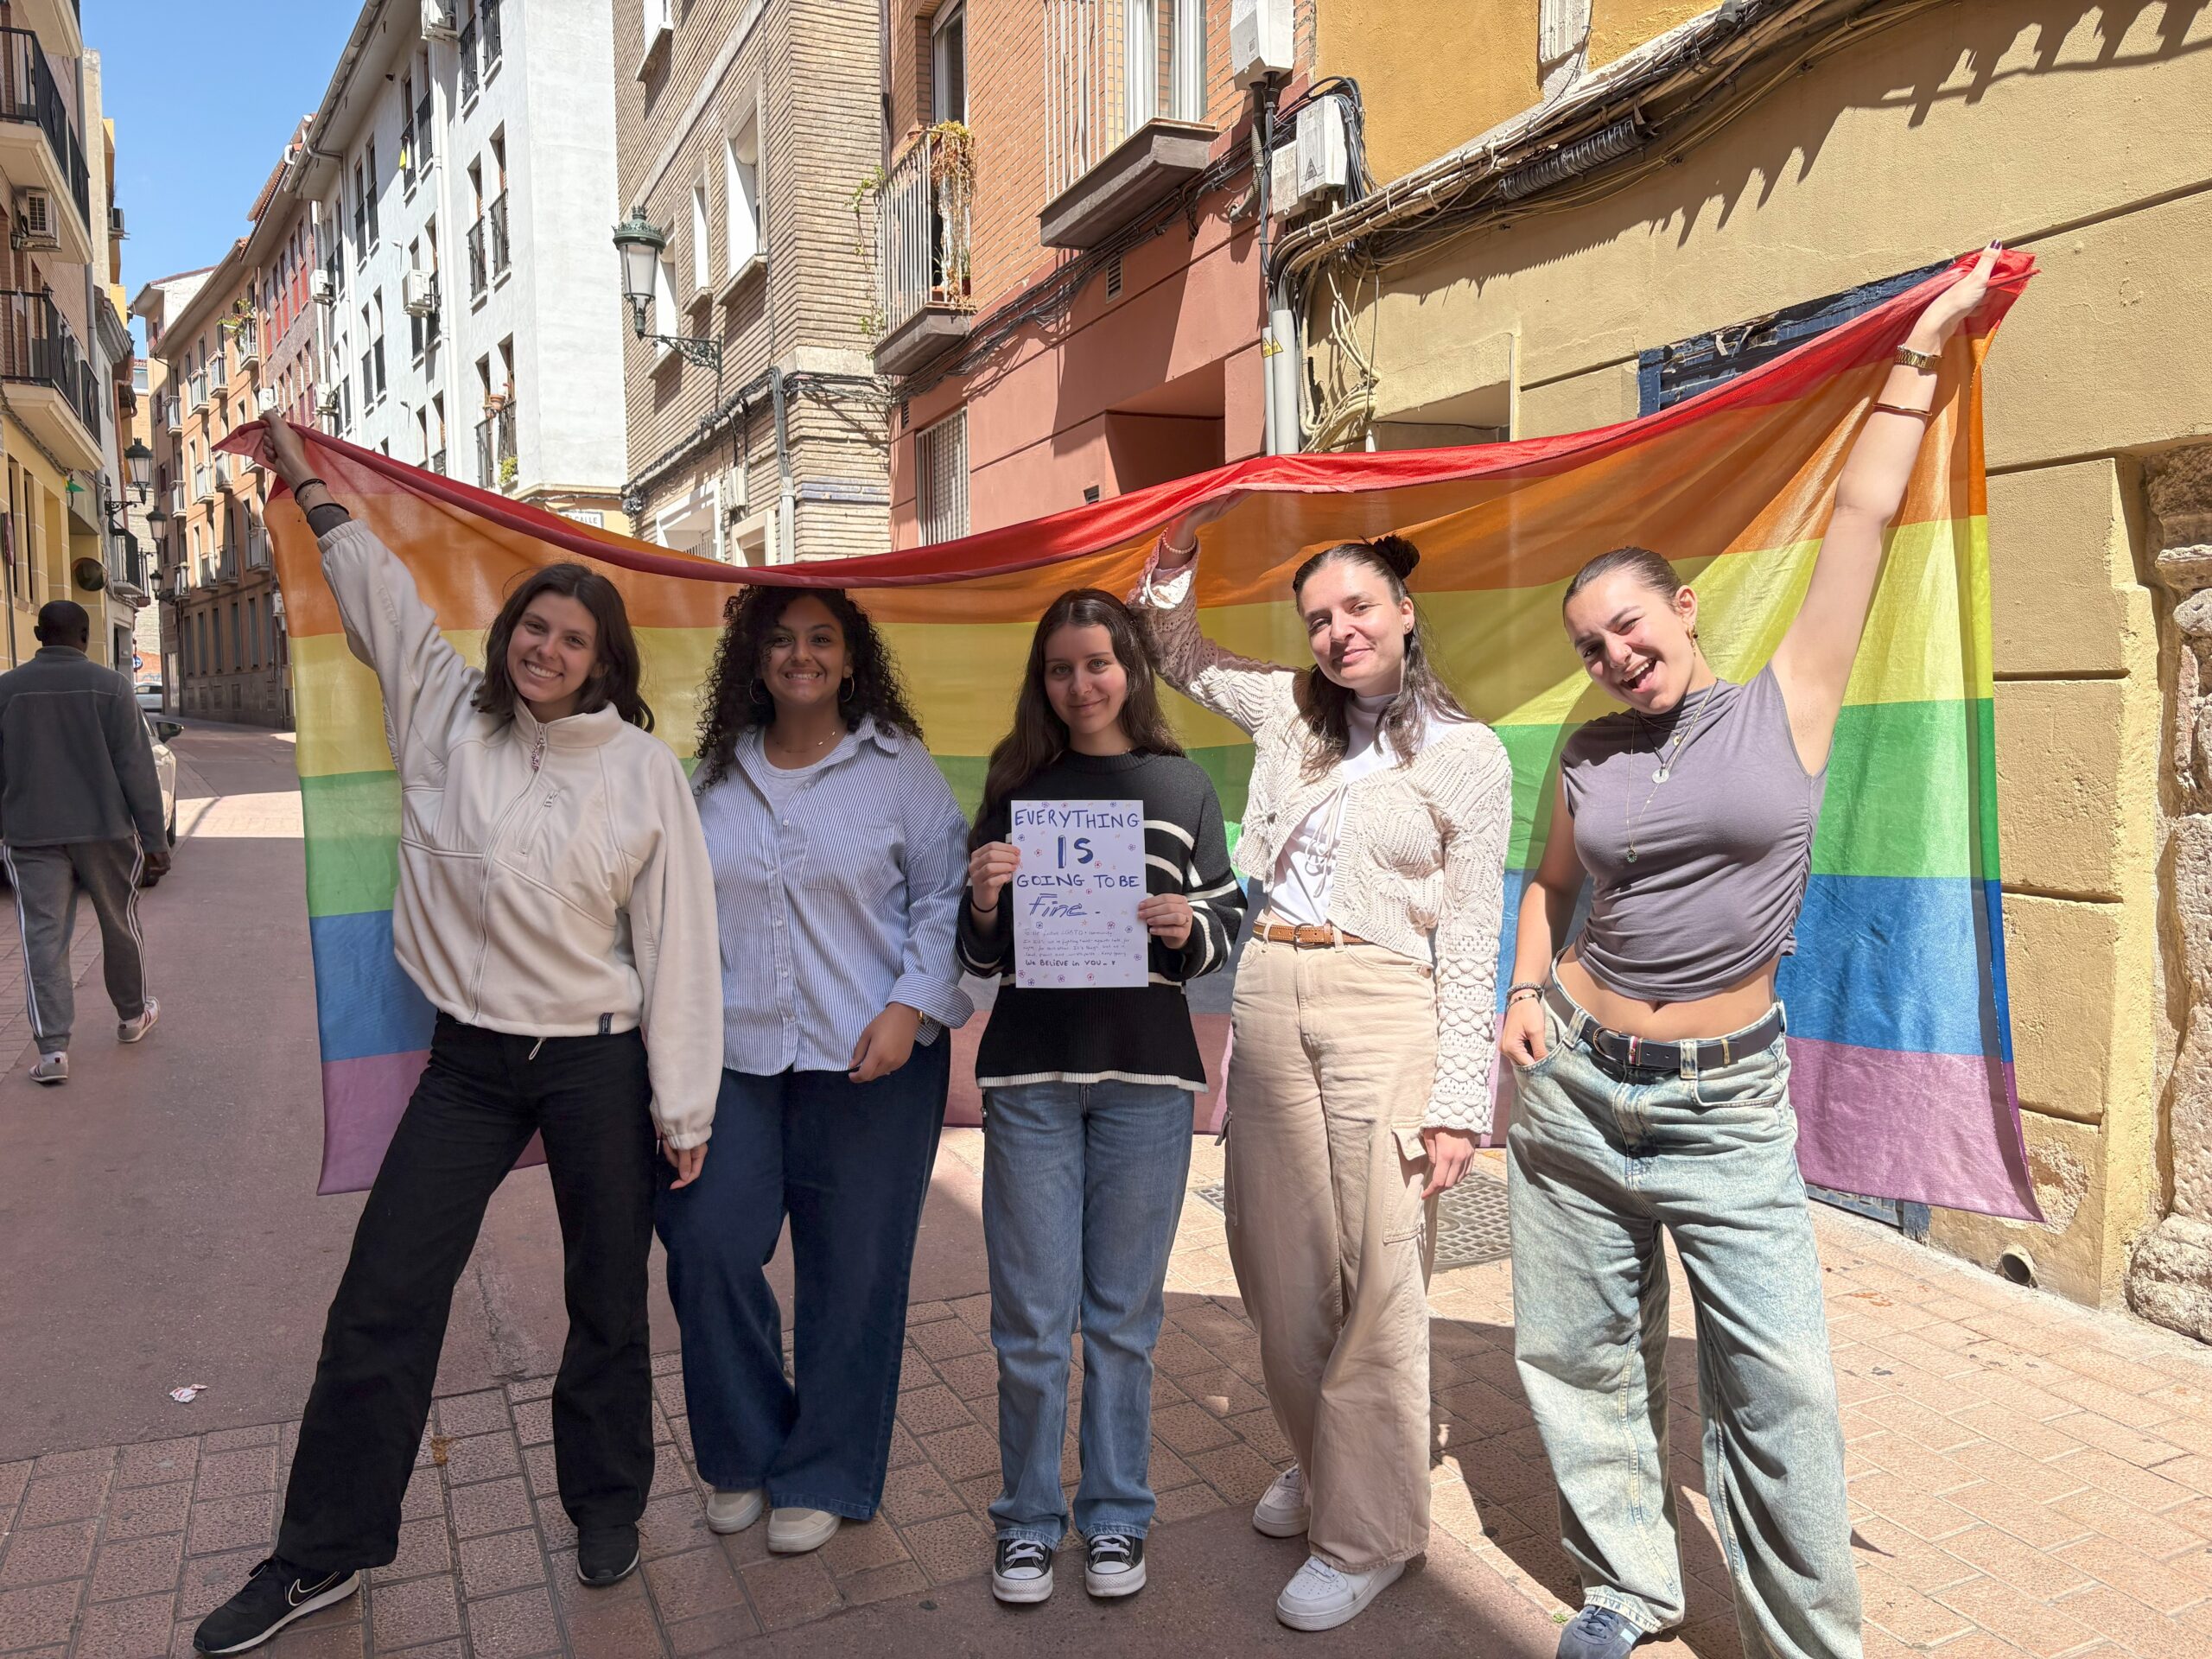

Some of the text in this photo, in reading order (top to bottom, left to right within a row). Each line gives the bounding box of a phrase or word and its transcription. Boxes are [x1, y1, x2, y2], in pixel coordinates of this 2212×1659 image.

[1014, 808, 1140, 829] EVERYTHING
[1058, 835, 1094, 869] IS
[1016, 874, 1140, 888] GOING TO BE
